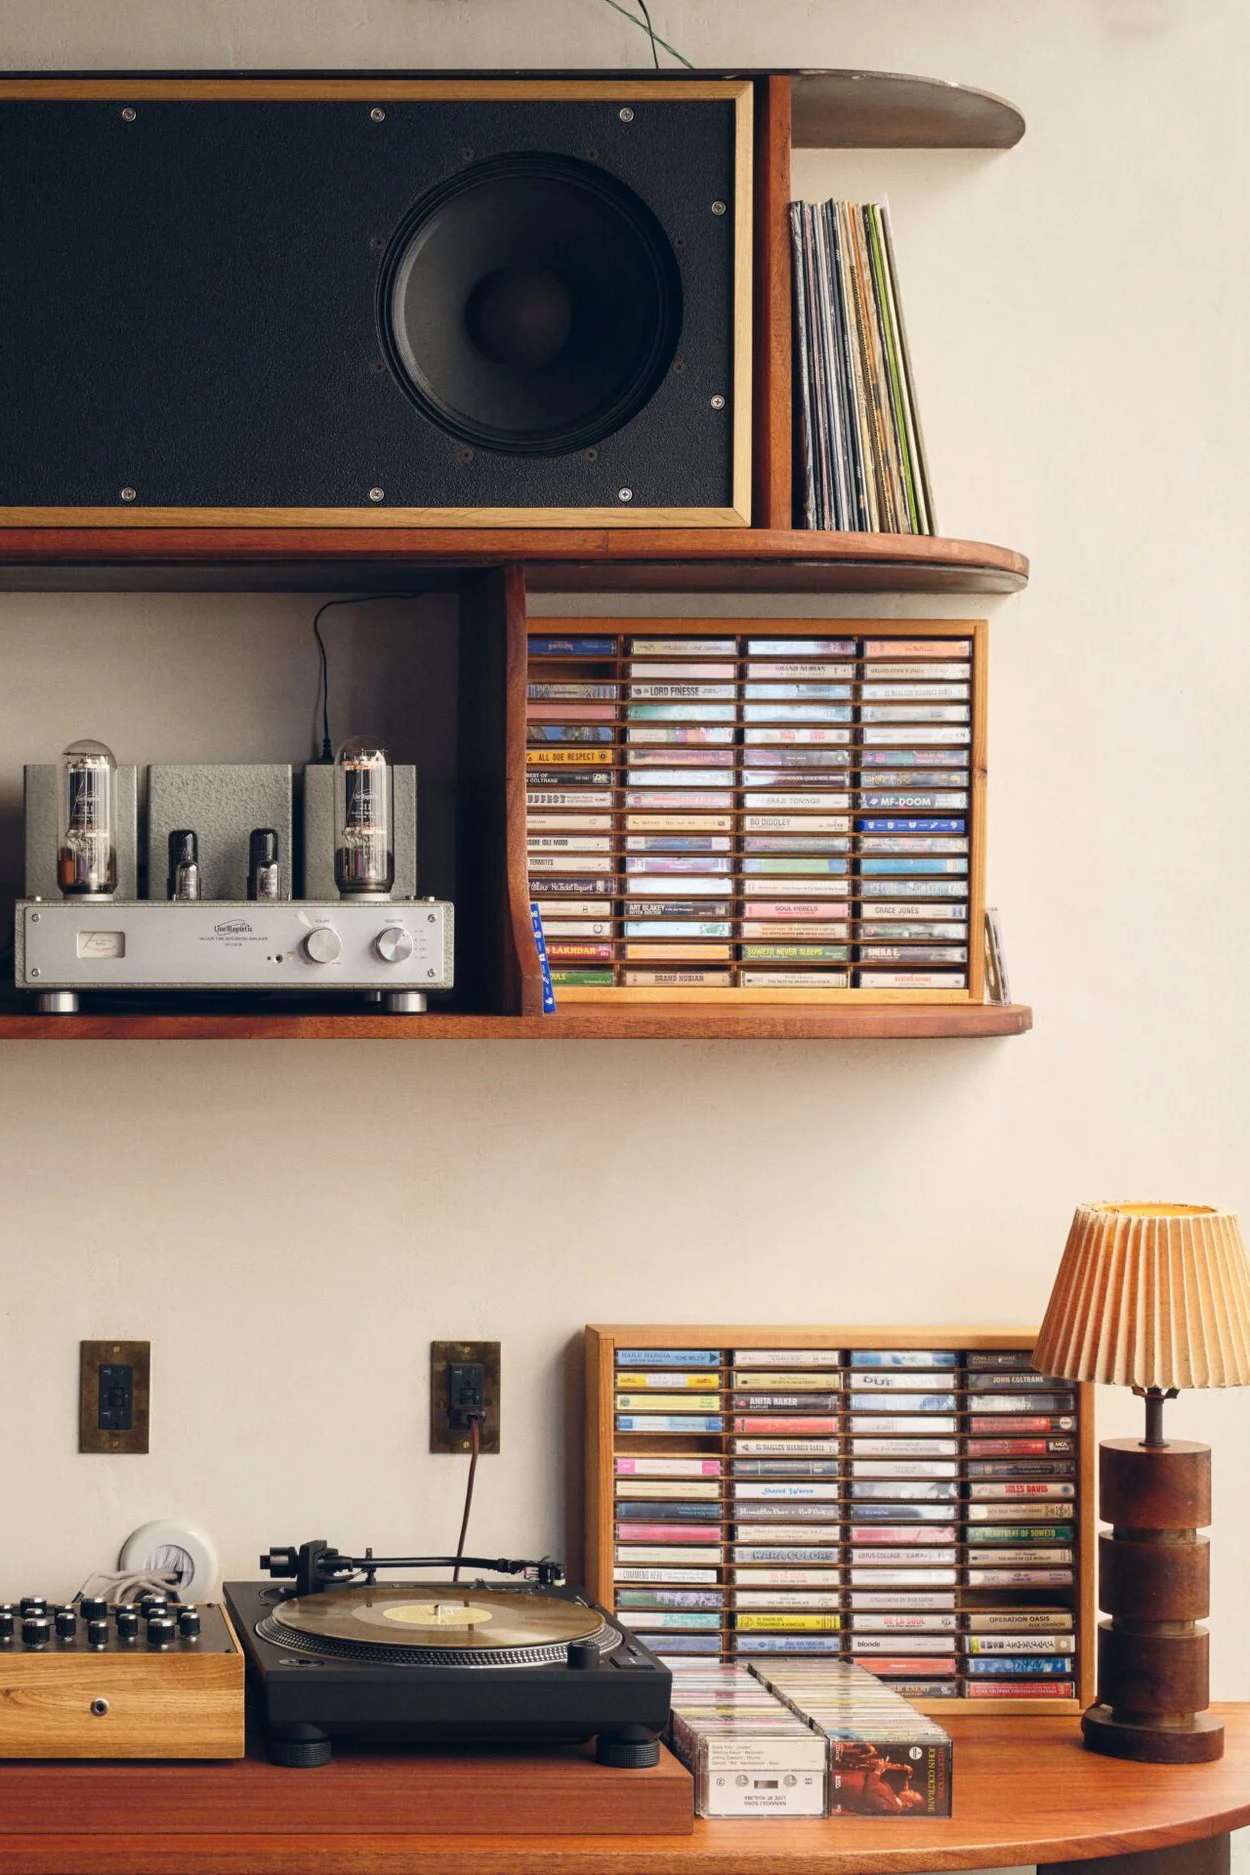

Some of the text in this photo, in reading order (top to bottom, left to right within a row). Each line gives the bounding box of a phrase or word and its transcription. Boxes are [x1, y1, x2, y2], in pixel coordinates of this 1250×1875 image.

[650, 686, 699, 696] LORD FINESSE
[538, 752, 595, 761] ALL DUE RESPECT
[880, 798, 931, 806] MF-DOOM
[642, 904, 664, 912] BLAKEY
[226, 924, 253, 933] Magnetic
[798, 948, 822, 956] SLEEPS
[750, 1397, 771, 1405] ANITA
[1026, 1485, 1048, 1493] DAVIS
